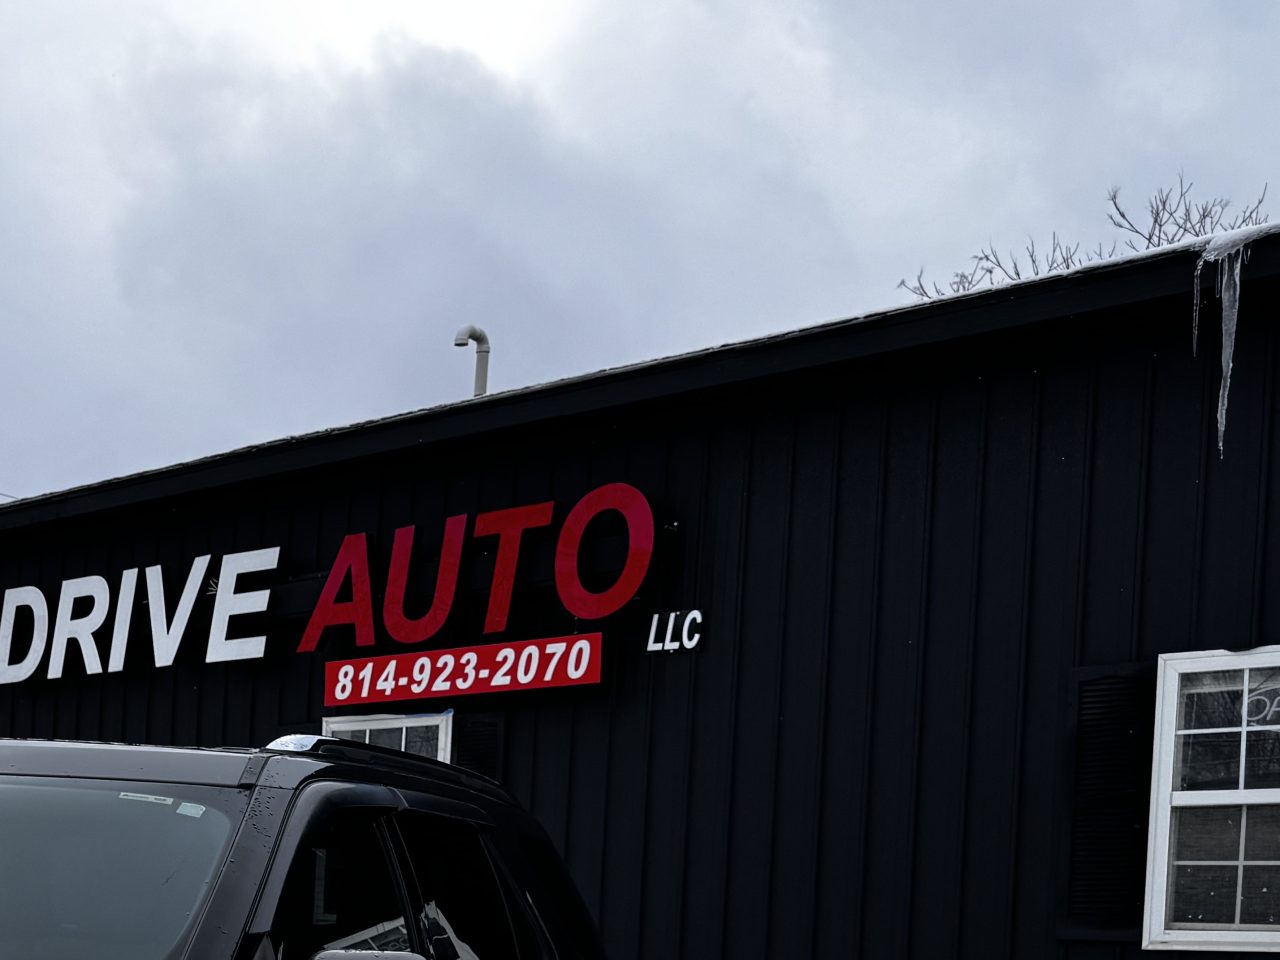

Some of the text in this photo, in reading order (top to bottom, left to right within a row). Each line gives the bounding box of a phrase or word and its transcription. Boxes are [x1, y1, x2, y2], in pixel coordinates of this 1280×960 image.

[296, 483, 655, 653] AUTO
[646, 610, 702, 652] LLC
[334, 640, 591, 700] 814-923-2070
